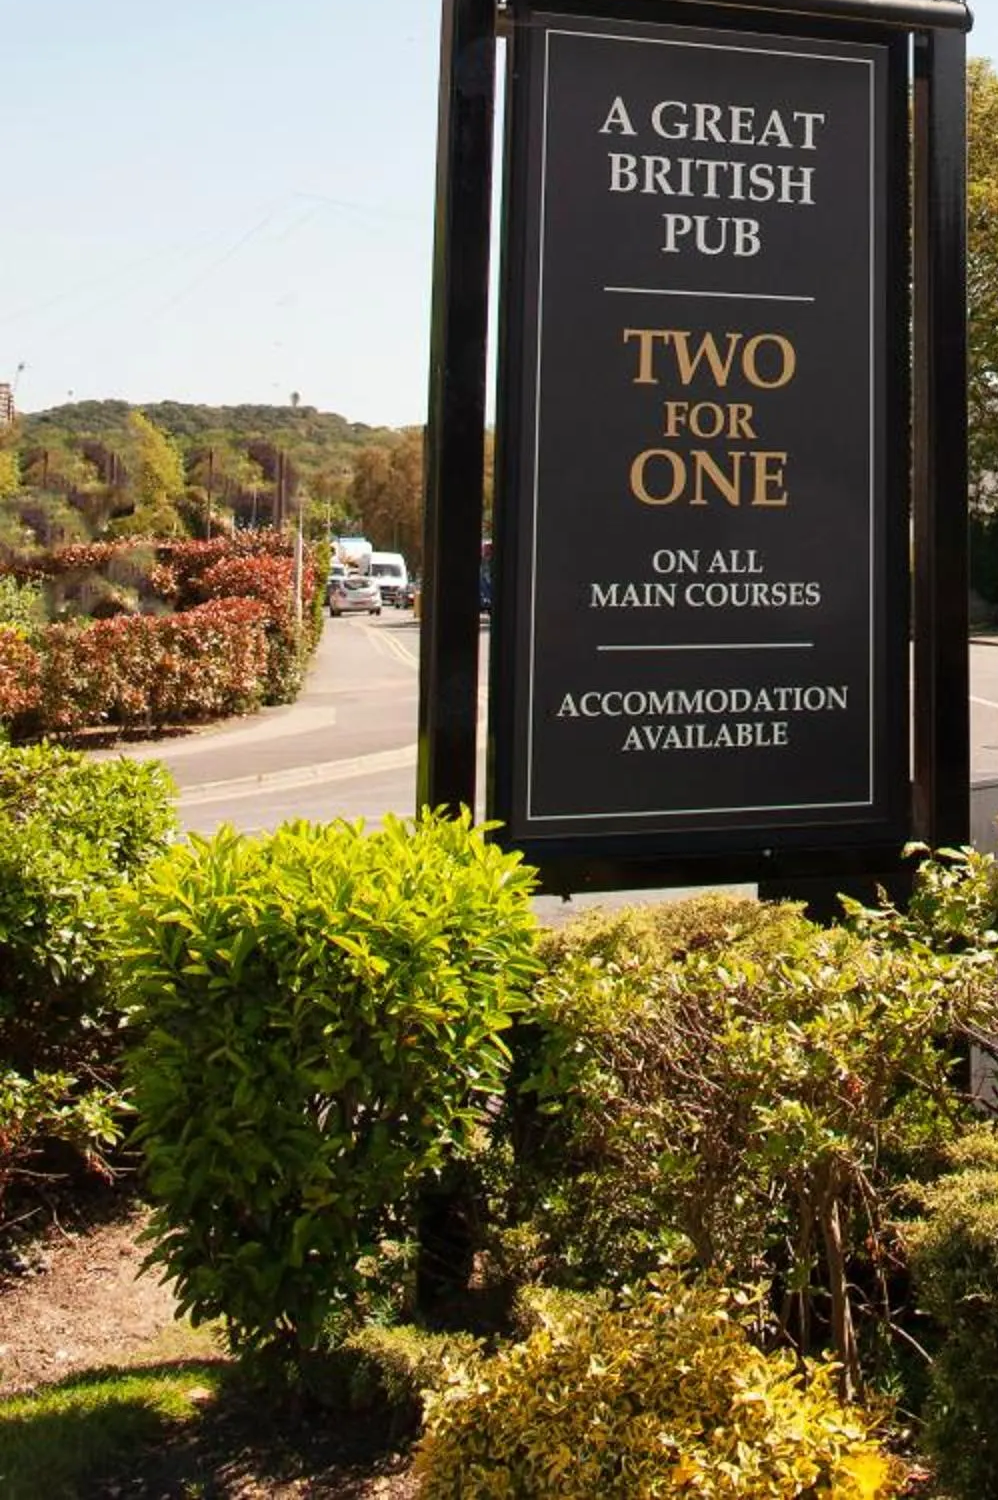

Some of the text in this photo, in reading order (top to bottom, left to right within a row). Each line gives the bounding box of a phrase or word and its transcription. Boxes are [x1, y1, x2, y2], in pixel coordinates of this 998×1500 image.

[598, 95, 825, 150] A GREAT
[608, 152, 816, 205] BRITISH
[661, 214, 762, 256] PUB
[623, 328, 797, 389] TWO
[663, 401, 758, 439] FOR
[630, 448, 788, 506] ONE
[652, 548, 763, 574] ON ALL
[590, 582, 821, 608] MAIN COURSES
[557, 686, 848, 716] ACCOMMODATION
[622, 722, 789, 751] AVAILABLE
